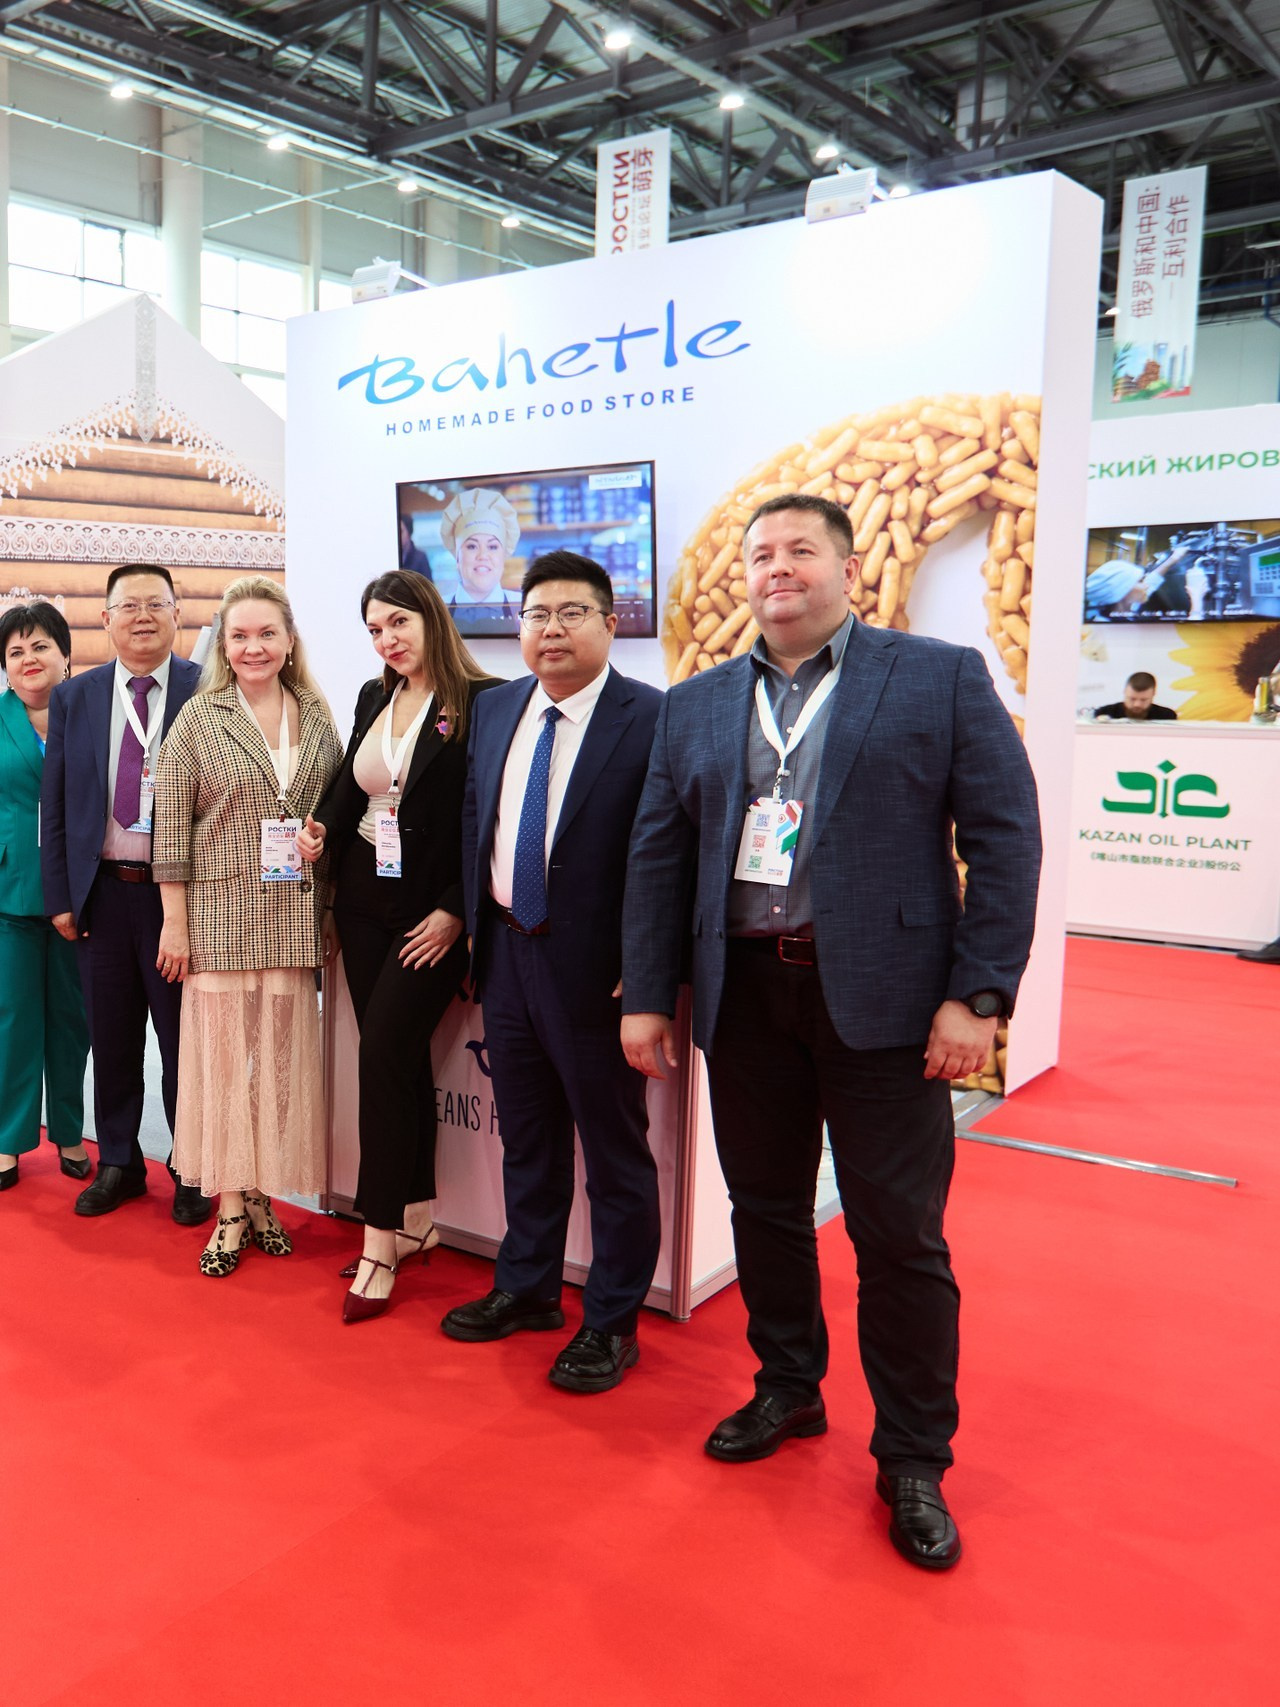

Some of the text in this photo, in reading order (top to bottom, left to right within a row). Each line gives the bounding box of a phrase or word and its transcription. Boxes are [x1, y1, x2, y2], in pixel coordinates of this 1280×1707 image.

[338, 299, 751, 404] Bahetle
[386, 386, 695, 436] HOMEMADE FOOD STORE
[1078, 829, 1252, 851] KAZAN OIL PLANT
